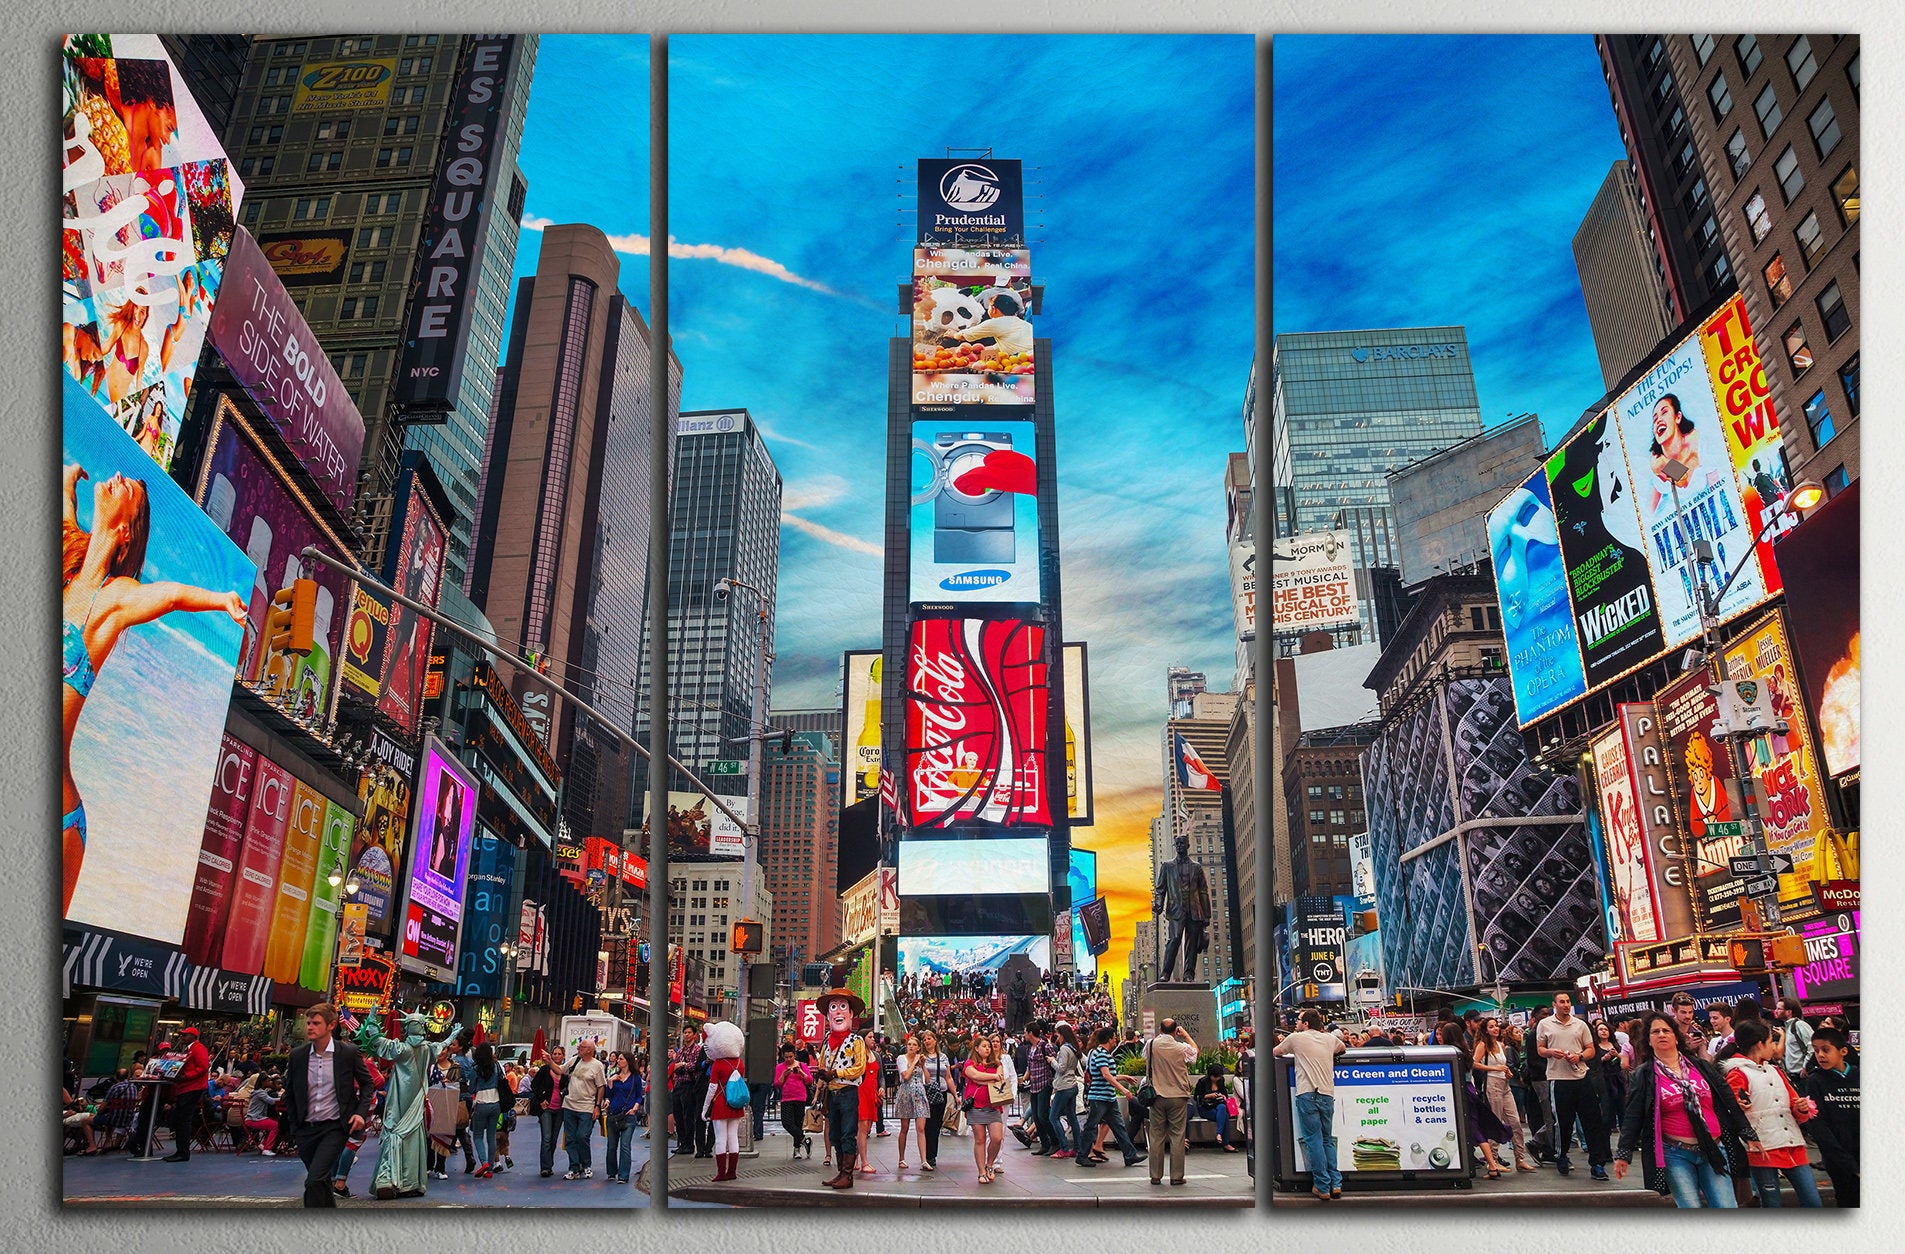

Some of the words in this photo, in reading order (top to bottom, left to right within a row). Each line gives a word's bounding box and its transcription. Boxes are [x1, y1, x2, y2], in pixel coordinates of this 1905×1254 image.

[310, 66, 384, 91] Z100
[314, 101, 346, 109] Music
[348, 99, 383, 107] Station
[935, 214, 1006, 225] Prudential
[418, 123, 486, 339] SQUARE
[993, 250, 1013, 258] Live.
[916, 258, 980, 271] Chengdu,
[1004, 262, 1030, 270] China.
[252, 277, 286, 348] THE
[282, 333, 327, 408] BOLD
[1373, 345, 1457, 361] BARCLAYS
[410, 367, 440, 378] NYC
[1636, 373, 1655, 396] THE
[1656, 355, 1677, 379] FUN
[930, 381, 959, 390] Where
[960, 380, 995, 390] Pandas
[996, 382, 1019, 390] Live.
[1627, 389, 1656, 420] NEVER
[1657, 357, 1693, 395] STOPS!
[239, 319, 281, 393] SIDE
[280, 376, 304, 417] OF
[302, 403, 347, 487] WATER
[915, 390, 985, 404] Chengdu,
[677, 420, 714, 431] llianz
[1653, 488, 1739, 575] MAMMA
[1297, 569, 1317, 577] TONY
[1317, 564, 1348, 574] AWARDS
[1573, 563, 1602, 588] BIGGEST
[948, 575, 1004, 585] SAMSUNG
[1294, 572, 1349, 585] MUSICAL
[1302, 582, 1350, 600] BEST
[1273, 599, 1328, 615] USICAL
[1329, 595, 1351, 608] OF
[350, 607, 374, 666] Q
[1514, 624, 1571, 671] PHANTOM
[1755, 644, 1783, 672] MUELLER
[1527, 665, 1566, 697] OPERA
[223, 734, 253, 758] SPARKLING
[377, 738, 395, 763] JOY
[859, 746, 880, 758] Coro
[213, 746, 251, 802] ICE
[718, 762, 728, 773] 46
[257, 771, 289, 823] ICE
[726, 798, 736, 809] By
[1636, 716, 1683, 888] PALACE
[293, 793, 321, 840] ICE
[719, 823, 731, 832] did
[732, 824, 740, 832] it.
[1708, 825, 1716, 836] W
[1718, 824, 1729, 836] 46
[325, 813, 350, 857] ICE
[715, 835, 742, 844] LEADERSHIP
[1696, 834, 1745, 877] Annie
[211, 857, 231, 870] CALORIES
[1736, 862, 1754, 871] ONE
[356, 866, 391, 889] MOTOWN
[486, 873, 506, 887] Stanley
[1749, 883, 1760, 893] ONE
[1308, 927, 1346, 946] HERO
[1311, 951, 1329, 961] JUNE
[1329, 951, 1335, 960] 6
[134, 957, 153, 969] WE'RE
[131, 968, 149, 979] OPEN
[346, 966, 388, 990] ROXY
[1802, 957, 1855, 987] SQUARE
[230, 980, 247, 992] WE'RE
[228, 991, 243, 1002] OPEN
[1608, 1005, 1618, 1016] BOX
[1619, 1003, 1635, 1014] OFFICE
[1636, 1001, 1649, 1012] HERE
[1693, 997, 1711, 1010] ONEY
[802, 1003, 817, 1038] tkts
[1399, 1018, 1411, 1026] OUT
[1352, 1069, 1385, 1079] Green
[1388, 1069, 1408, 1078] and
[1411, 1067, 1445, 1077] Clean!
[1356, 1096, 1390, 1106] recycle
[1412, 1094, 1446, 1104] recycle
[1823, 1093, 1860, 1102] abercro
[1413, 1105, 1447, 1114] bottles
[1361, 1117, 1388, 1127] paper
[1415, 1115, 1422, 1124] &
